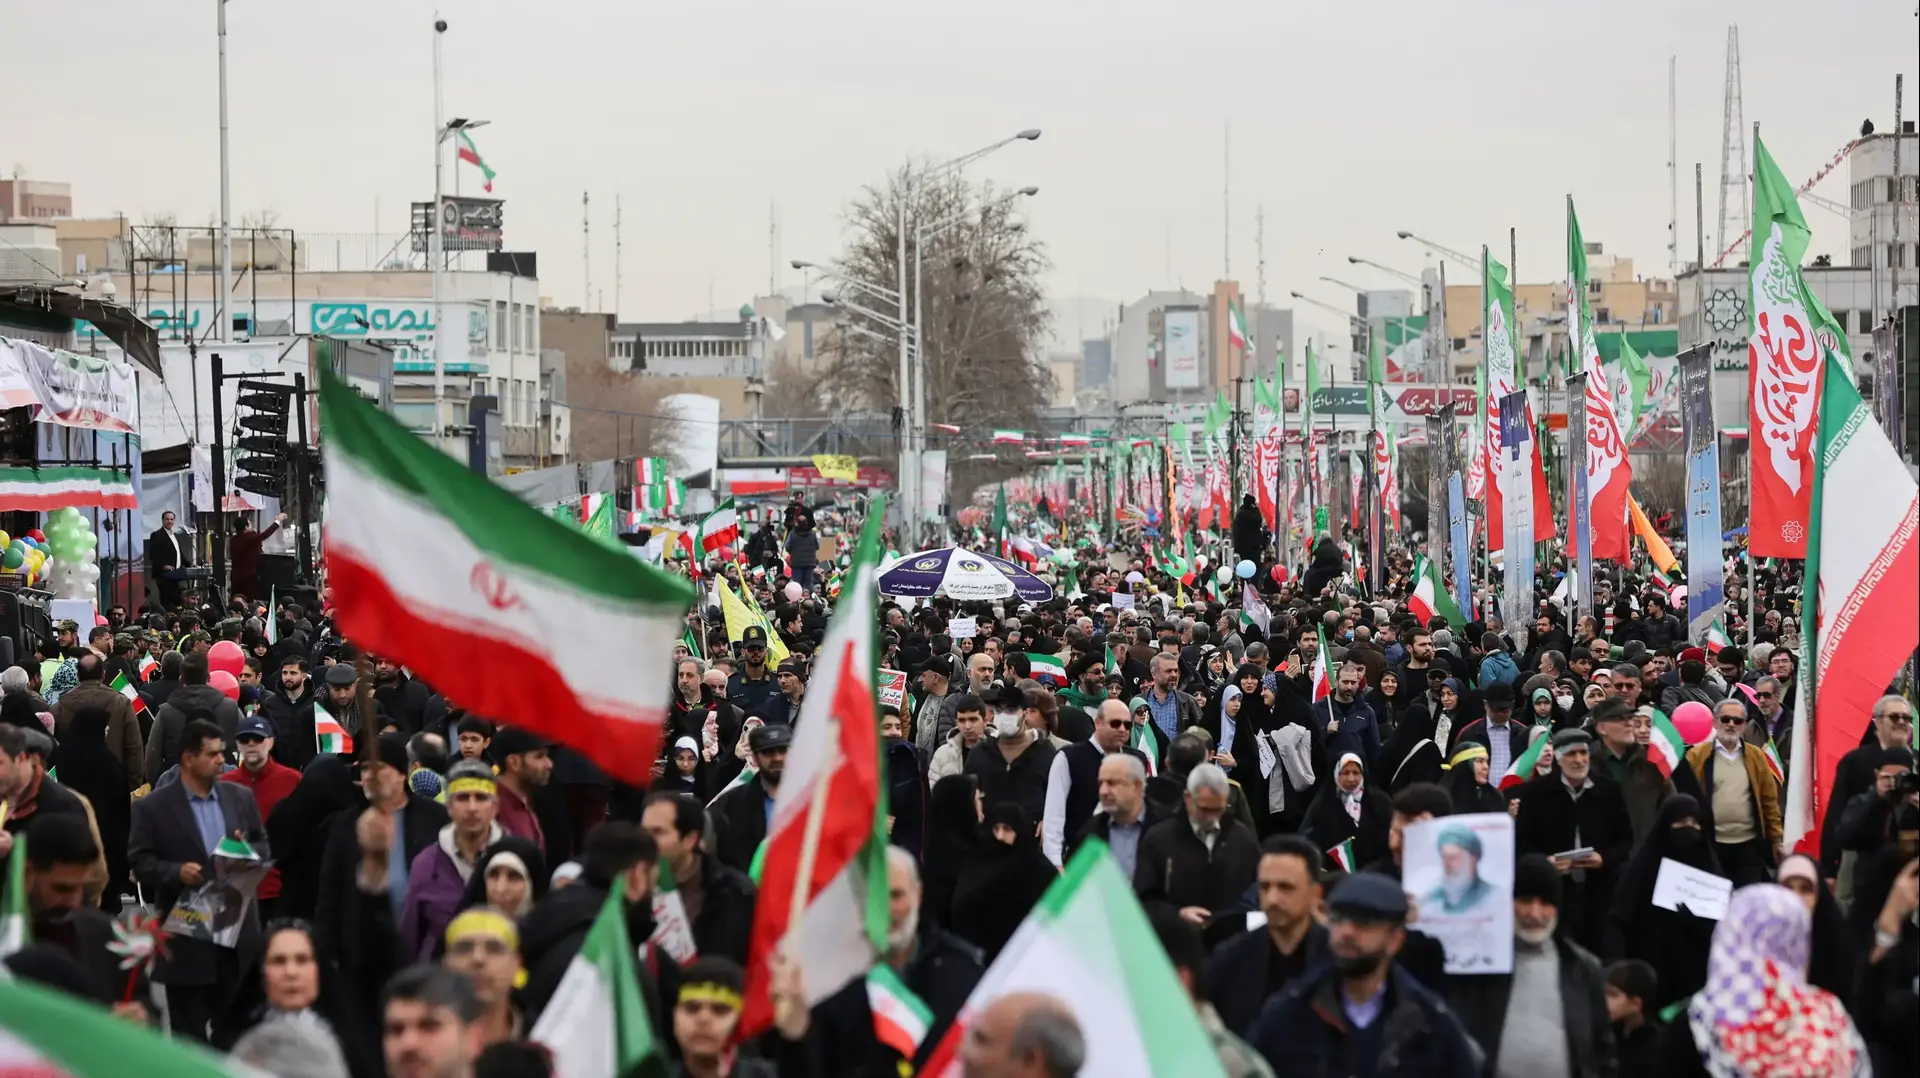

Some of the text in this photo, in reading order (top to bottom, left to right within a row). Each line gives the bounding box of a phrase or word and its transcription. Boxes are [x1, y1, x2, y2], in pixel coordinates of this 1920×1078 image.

[148, 307, 200, 339] بیم
[1714, 336, 1748, 354] شهردار
[1713, 358, 1748, 371] منطق
